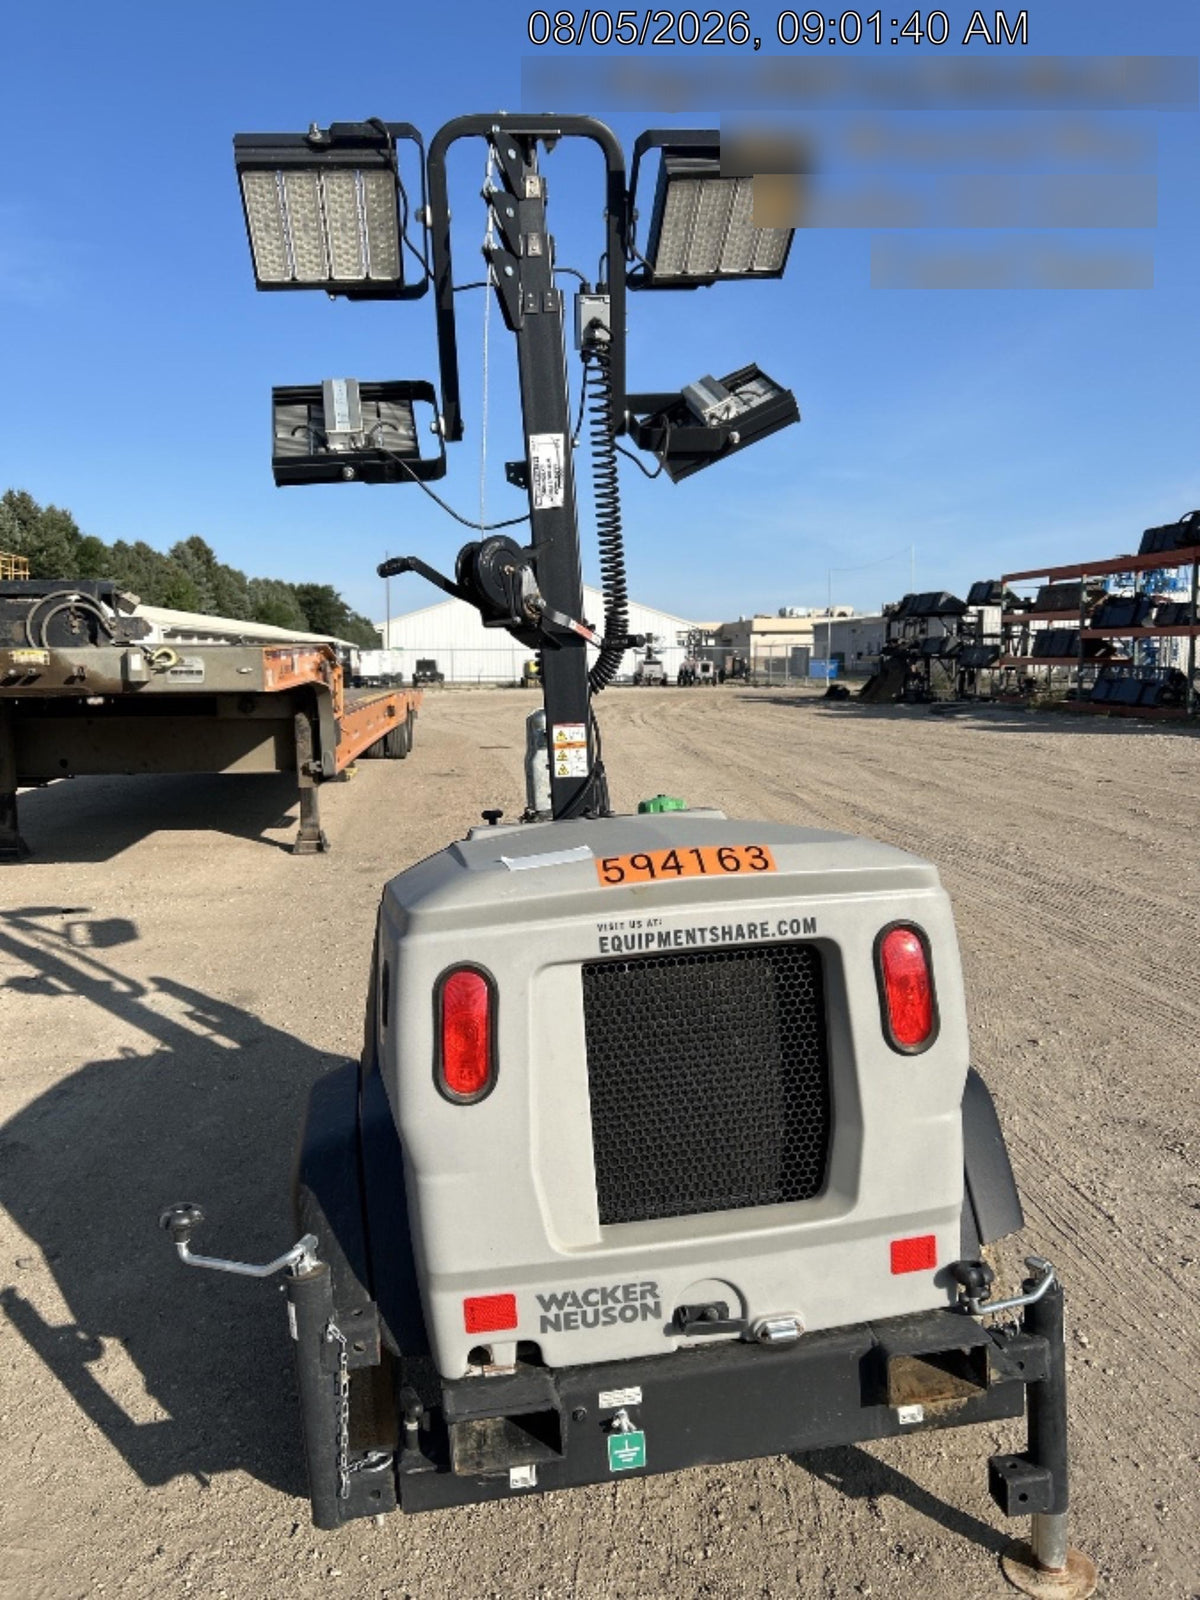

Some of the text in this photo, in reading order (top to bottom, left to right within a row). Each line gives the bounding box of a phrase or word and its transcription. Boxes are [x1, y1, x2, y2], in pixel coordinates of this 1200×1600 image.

[602, 845, 770, 884] 594163
[597, 922, 624, 932] VISIT
[629, 920, 642, 929] US
[599, 917, 817, 953] EQUIPMENTSHARE.COM
[535, 1281, 660, 1313] WACKER
[540, 1301, 661, 1334] NEUSON
